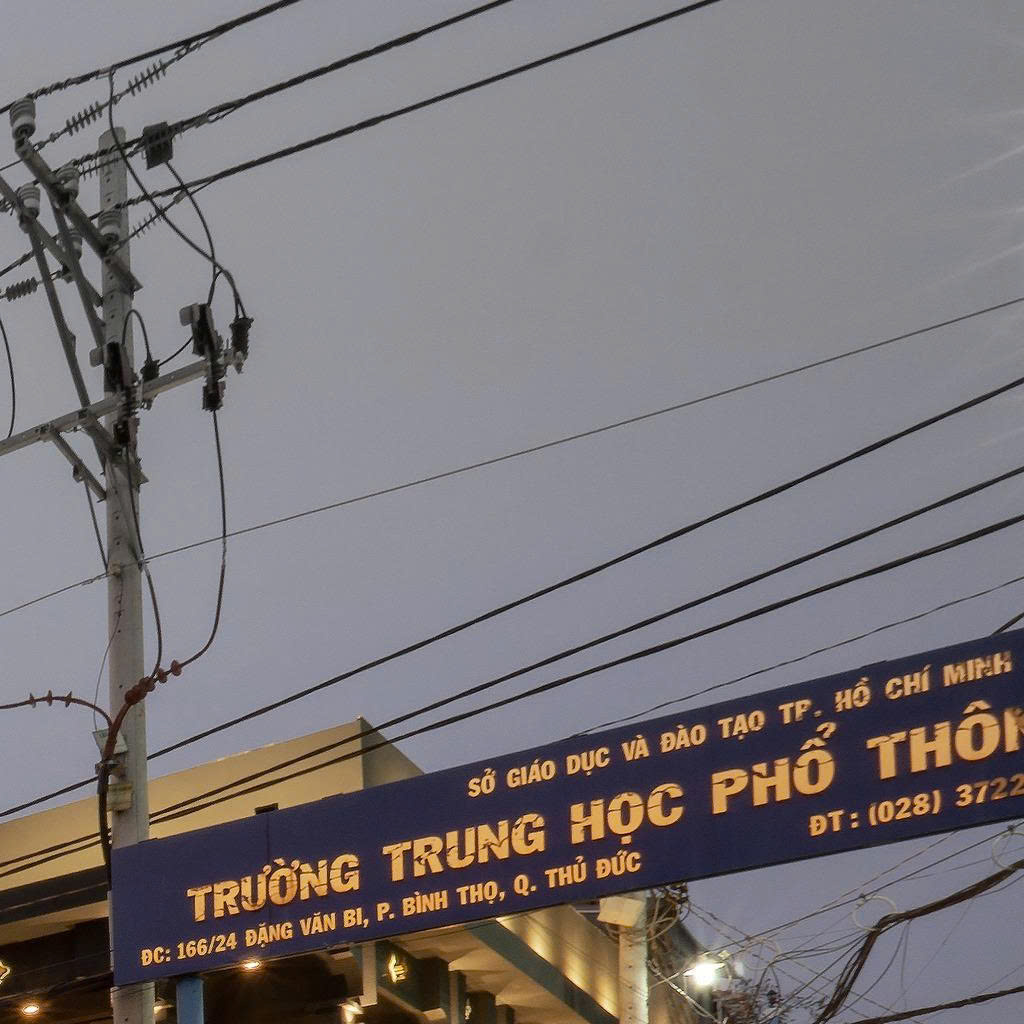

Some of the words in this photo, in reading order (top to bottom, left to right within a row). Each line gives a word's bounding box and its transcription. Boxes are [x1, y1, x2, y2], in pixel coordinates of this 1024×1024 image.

[468, 768, 496, 797] SỞ
[506, 759, 556, 789] GIÁO
[566, 747, 610, 777] DỤC
[621, 731, 649, 761] VÀ
[660, 721, 706, 752] ĐÀO
[718, 710, 766, 741] TẠO
[778, 699, 823, 725] TP.
[834, 676, 872, 713] HỒ
[884, 664, 931, 701] CHÍ
[942, 650, 1013, 687] MINH
[186, 853, 361, 923] TRƯỜNG
[382, 813, 546, 882] TRUNG
[570, 783, 685, 844] HỌC
[711, 721, 838, 815] PHỔ
[868, 790, 942, 827] (028)
[141, 946, 171, 967] ĐC:
[177, 931, 237, 960] 166/24
[245, 922, 293, 948] ĐẶNG
[299, 911, 336, 936] VĂN
[343, 907, 369, 929] BI,
[377, 902, 394, 922] P.
[403, 891, 448, 916] BÌNH
[456, 881, 505, 905] THỌ,
[514, 874, 536, 896] Q.
[545, 856, 587, 888] THỦ
[596, 850, 642, 879] ĐỨC
